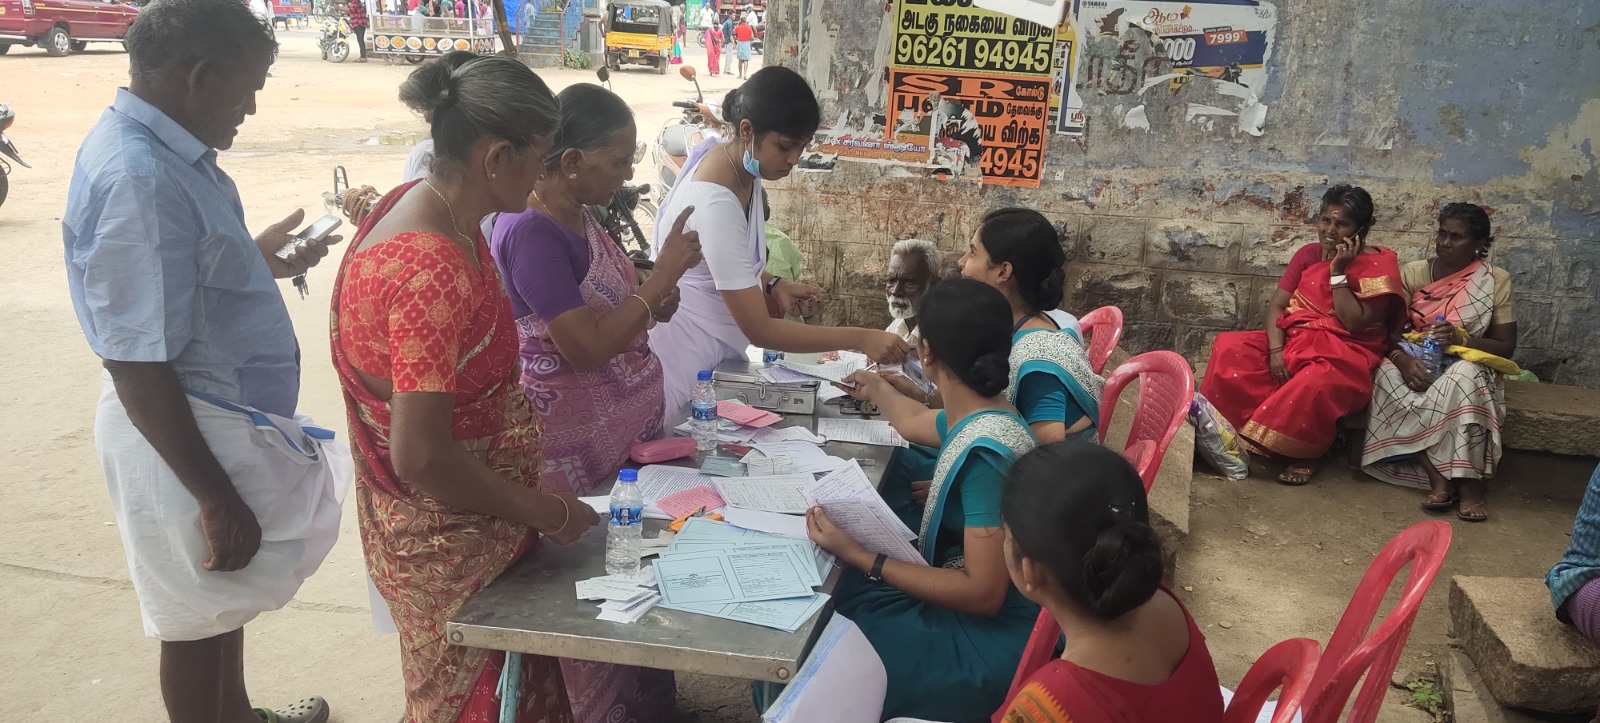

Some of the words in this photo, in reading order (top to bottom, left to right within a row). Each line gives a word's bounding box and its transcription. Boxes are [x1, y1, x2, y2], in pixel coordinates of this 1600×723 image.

[902, 9, 939, 37] அடகு
[942, 13, 1008, 39] நகையை
[897, 34, 967, 67] 96261
[973, 39, 1050, 72] 94945
[896, 74, 1015, 99] SR
[1015, 85, 1045, 100] கோல்டு
[1006, 102, 1043, 120] தேவைக்கு
[1001, 120, 1041, 151] விற்க
